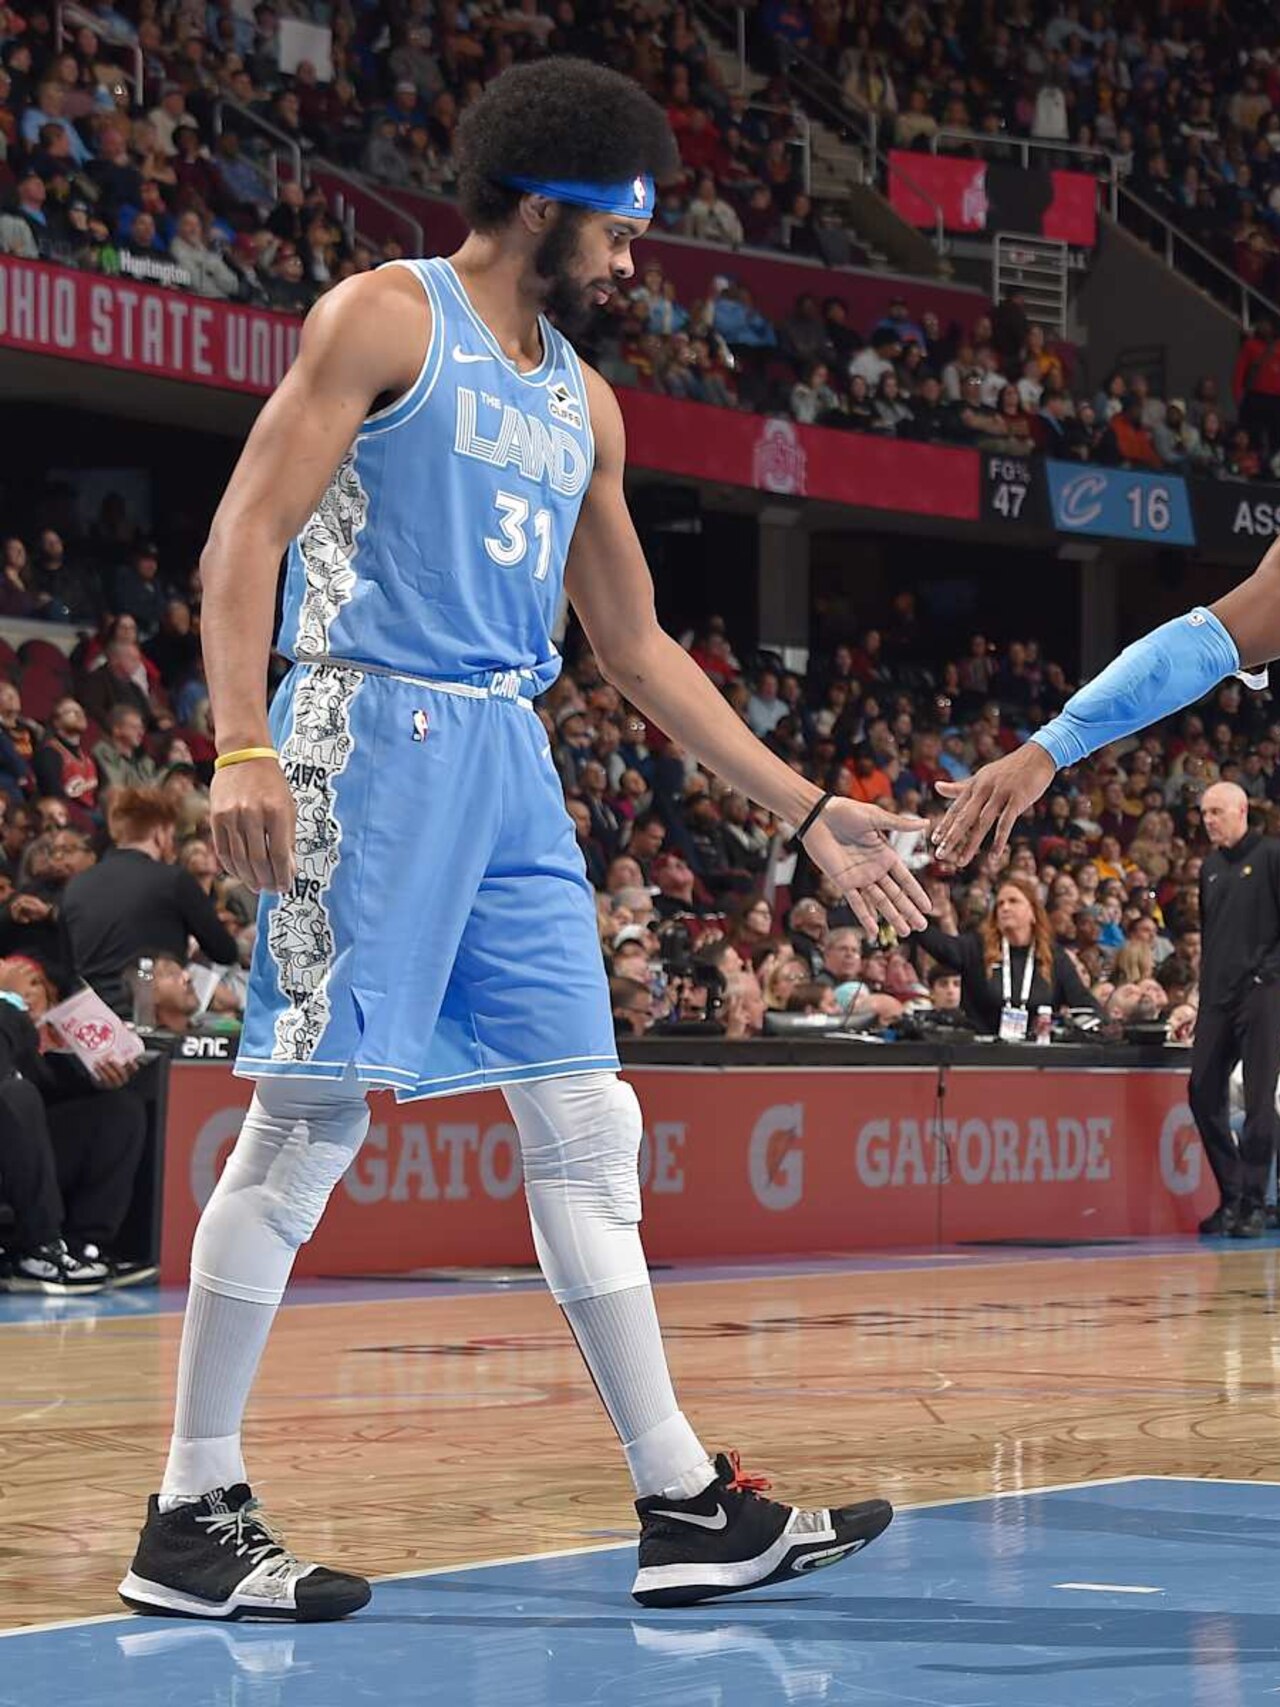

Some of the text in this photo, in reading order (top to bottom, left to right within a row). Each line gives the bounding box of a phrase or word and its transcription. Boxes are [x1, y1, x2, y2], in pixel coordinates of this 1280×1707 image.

[90, 284, 214, 376] STATE
[226, 313, 300, 388] UNI
[480, 391, 502, 410] THE
[454, 386, 587, 497] LAND
[484, 489, 550, 581] 31
[993, 482, 1027, 518] 47
[1126, 485, 1171, 532] 16
[181, 1036, 230, 1057] anc
[344, 1121, 685, 1205] GATOE
[749, 1103, 803, 1210] G
[855, 1117, 1112, 1188] GATORADE
